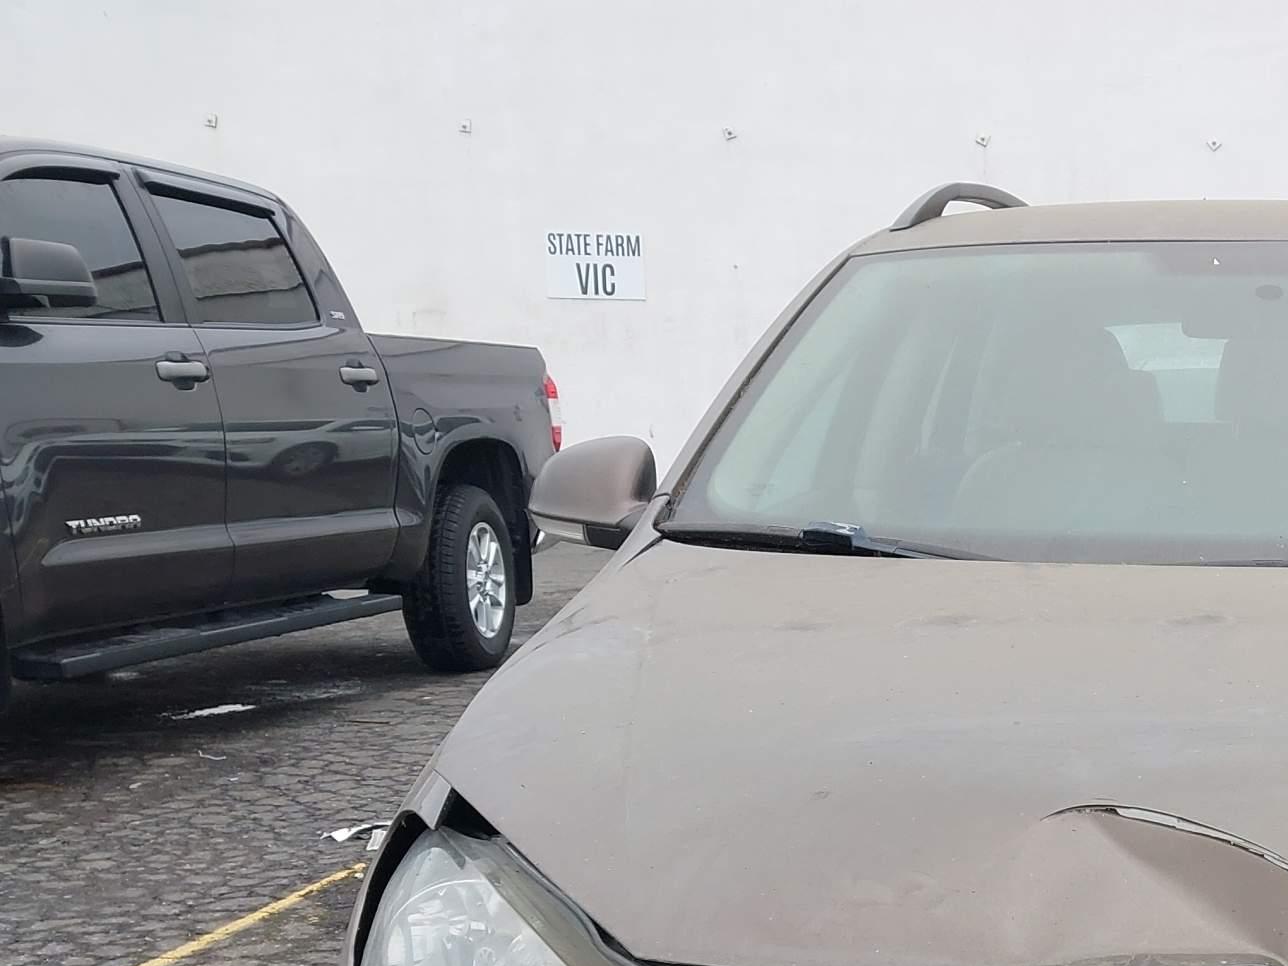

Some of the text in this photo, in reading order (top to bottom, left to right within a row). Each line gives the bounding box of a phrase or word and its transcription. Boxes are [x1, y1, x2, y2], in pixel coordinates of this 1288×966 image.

[547, 232, 641, 257] STATE FARM
[575, 262, 616, 296] VIC
[65, 514, 142, 535] TUNDRA
